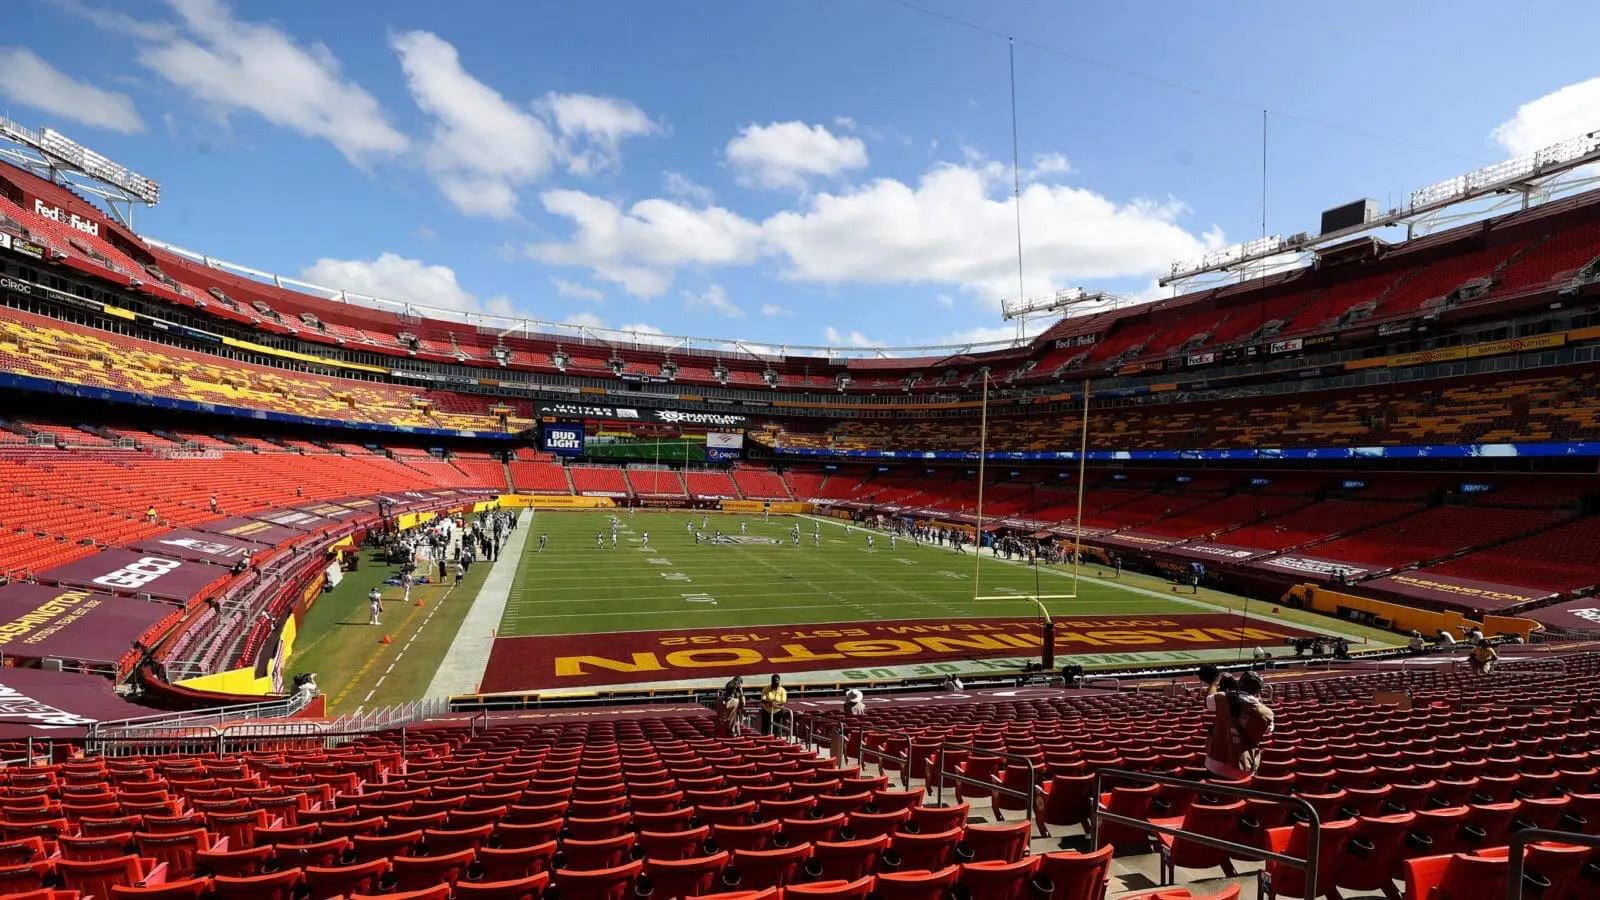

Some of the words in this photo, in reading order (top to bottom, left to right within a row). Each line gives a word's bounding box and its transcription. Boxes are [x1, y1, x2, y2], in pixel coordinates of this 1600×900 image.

[1271, 342, 1297, 352] FedEx
[1189, 355, 1209, 364] FedEx
[551, 430, 576, 440] BUD
[546, 438, 580, 449] LIGHT
[719, 450, 740, 460] pepsi
[92, 556, 182, 588] GEICO
[1390, 575, 1532, 602] WASHINGTON
[0, 590, 92, 646] ASHINGTON
[658, 632, 770, 646] 1932
[554, 626, 1295, 677] WASHINGTON
[841, 668, 897, 680] US
[912, 664, 961, 674] OF
